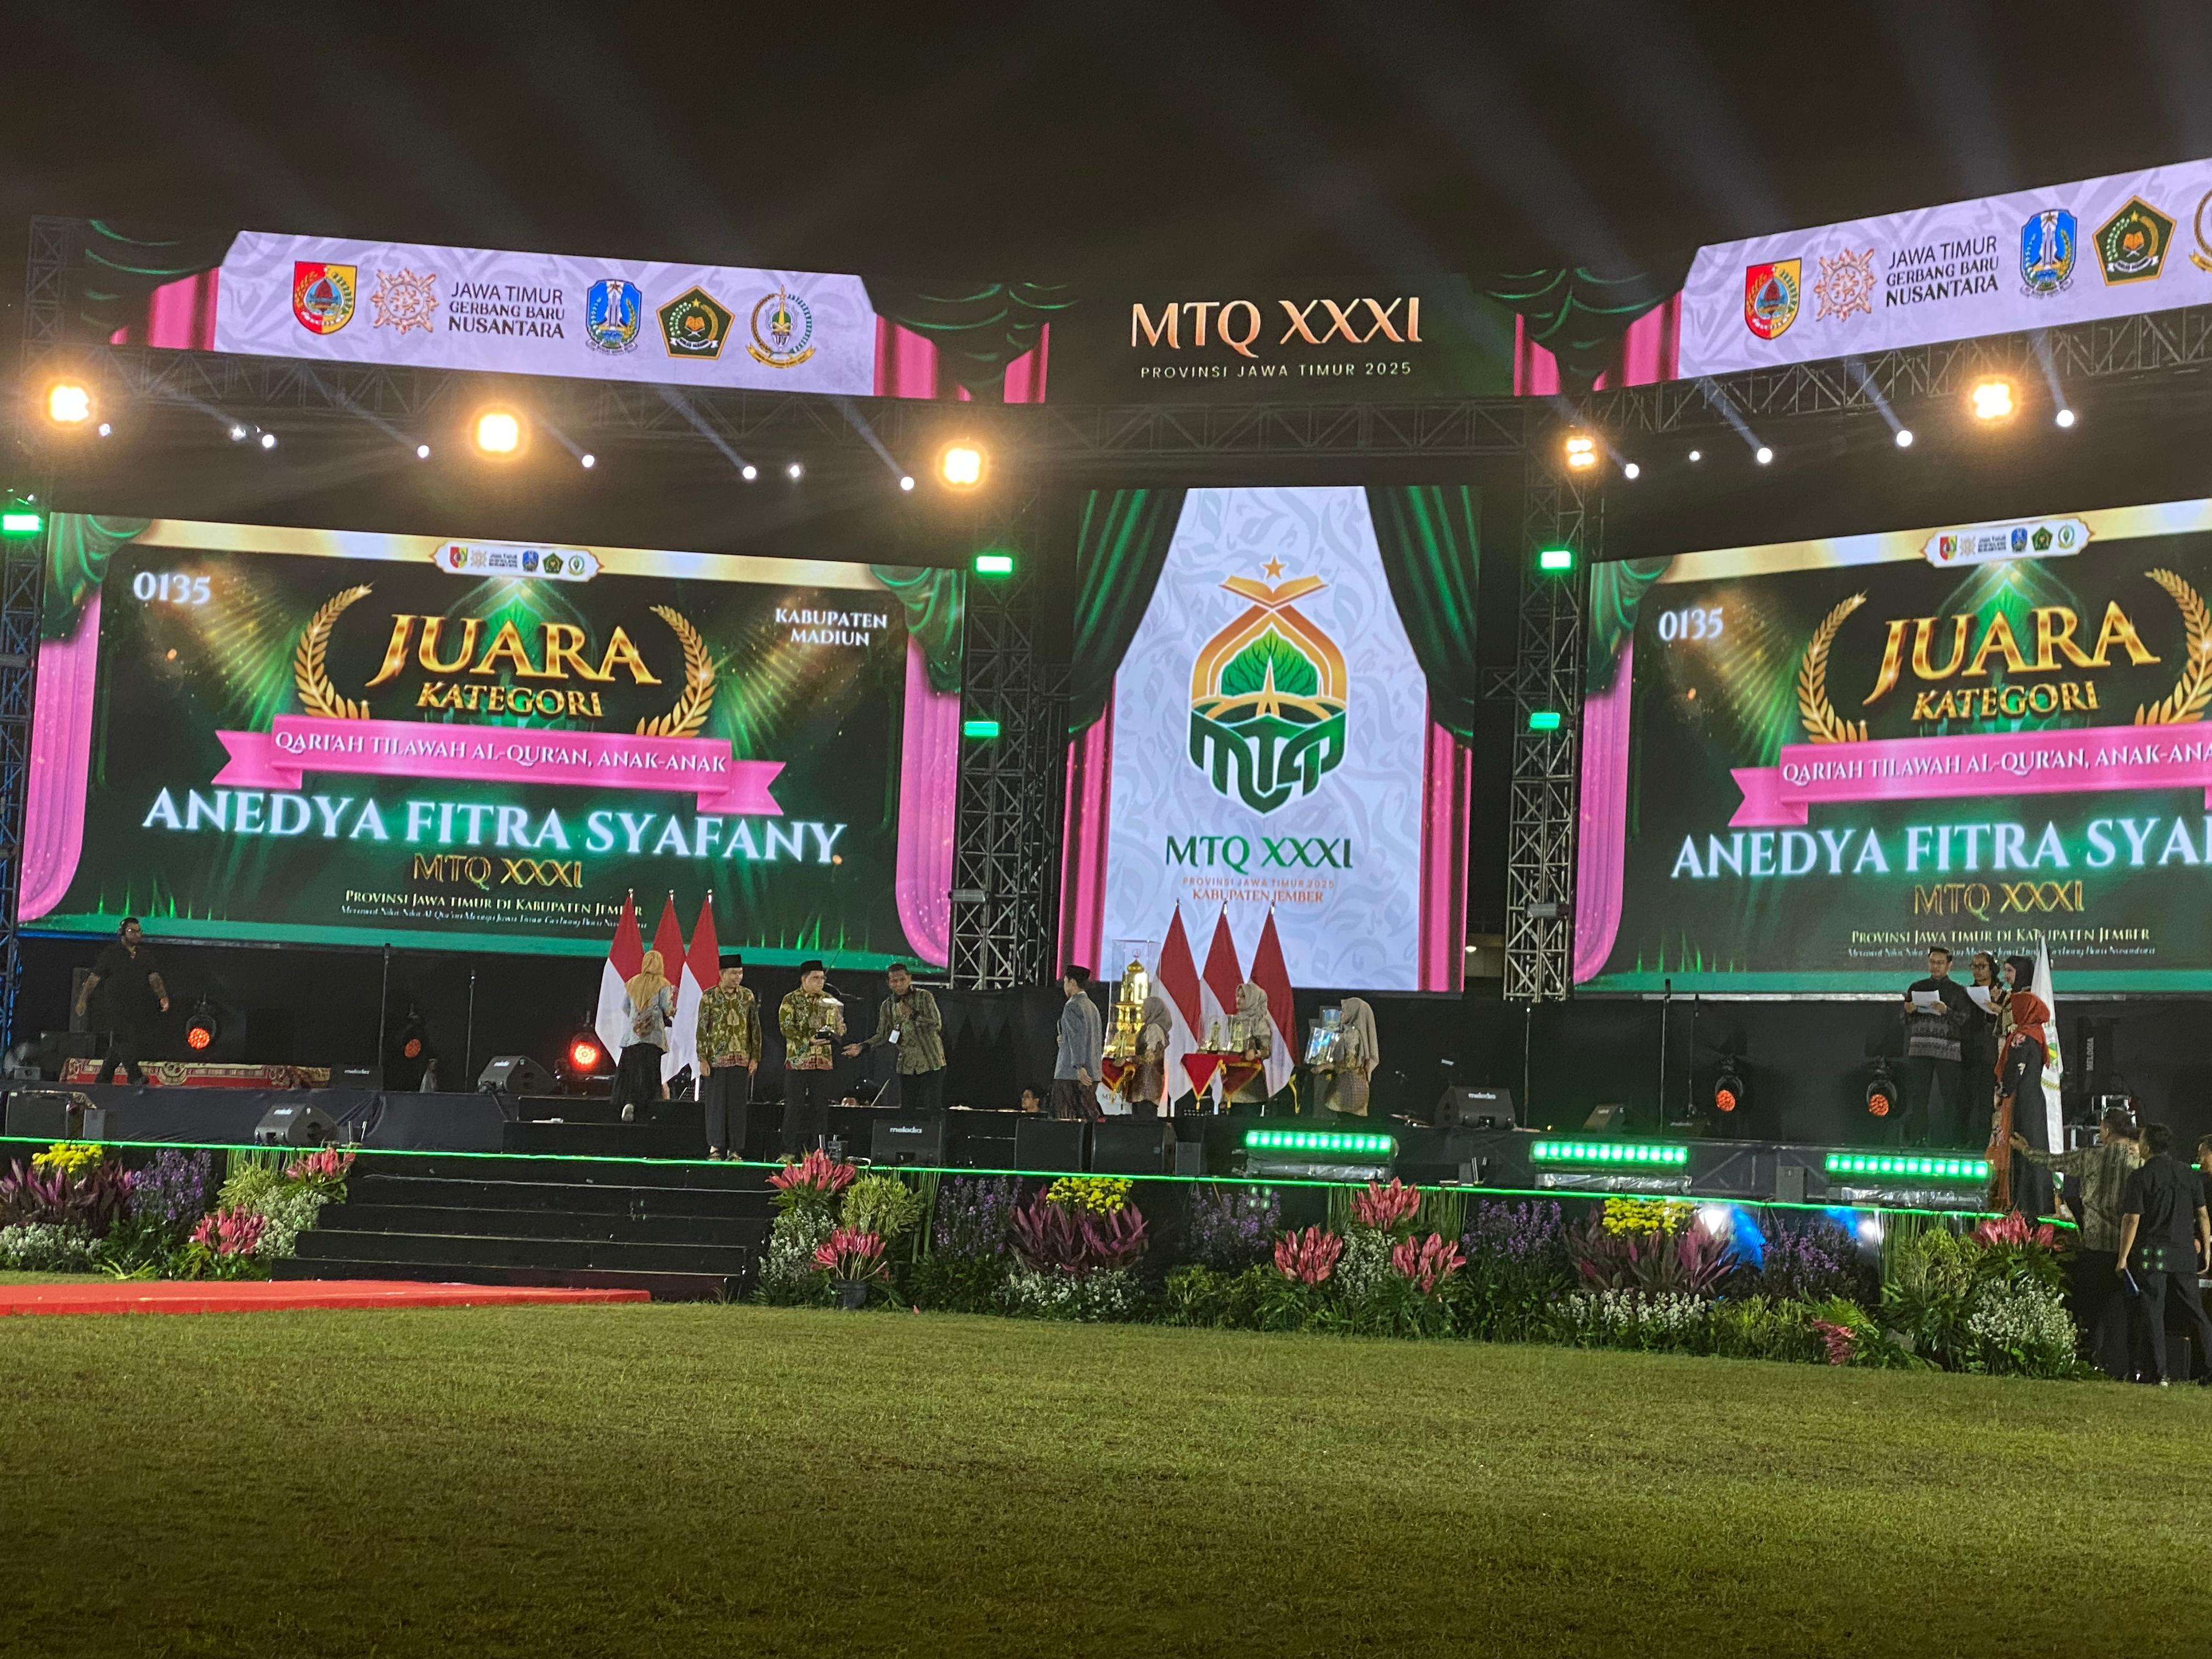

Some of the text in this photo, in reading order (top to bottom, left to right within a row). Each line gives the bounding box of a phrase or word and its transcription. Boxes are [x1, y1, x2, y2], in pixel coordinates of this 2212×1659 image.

[1888, 235, 1996, 269] JAWA TIMUR
[1887, 256, 1999, 286] GERBANG BARU
[452, 282, 562, 305] JAWA TIMUR
[1886, 274, 1998, 307] NUSANTARA
[449, 301, 565, 320] GERBANG BARU
[449, 316, 565, 338] NUSANTARA
[1131, 297, 1423, 358] MTQ XXXI
[1141, 362, 1412, 378] PROVINSI JAWA TIMUR 2025
[133, 571, 211, 603] 0135
[775, 608, 888, 629] KABUPATEN
[1659, 607, 1723, 641] 0135
[365, 614, 662, 687] JUARA
[791, 628, 870, 646] MADIUN
[1863, 600, 2161, 706] JUARA
[416, 681, 603, 717] KATEGORI
[1911, 681, 2100, 720] KATEGORI
[275, 732, 364, 754] QARI'AH
[369, 737, 466, 758] TILAWAH
[597, 751, 726, 772] ANAK-ANAK
[1783, 760, 1863, 786] QARI'AH
[1869, 755, 1961, 778] TILAWAH
[142, 787, 847, 864] ANEDYA FITRA SYAFANY
[1166, 835, 1353, 874] MTQ XXXI
[1670, 827, 1889, 878] ANEDYA
[1905, 820, 2069, 871] FITRA
[413, 853, 583, 891] MTQ XXXI
[1272, 879, 1304, 888] TIMUR
[1193, 888, 1323, 903] KABUPATEN JEMBER
[1914, 880, 2084, 921] MTQ XXXI
